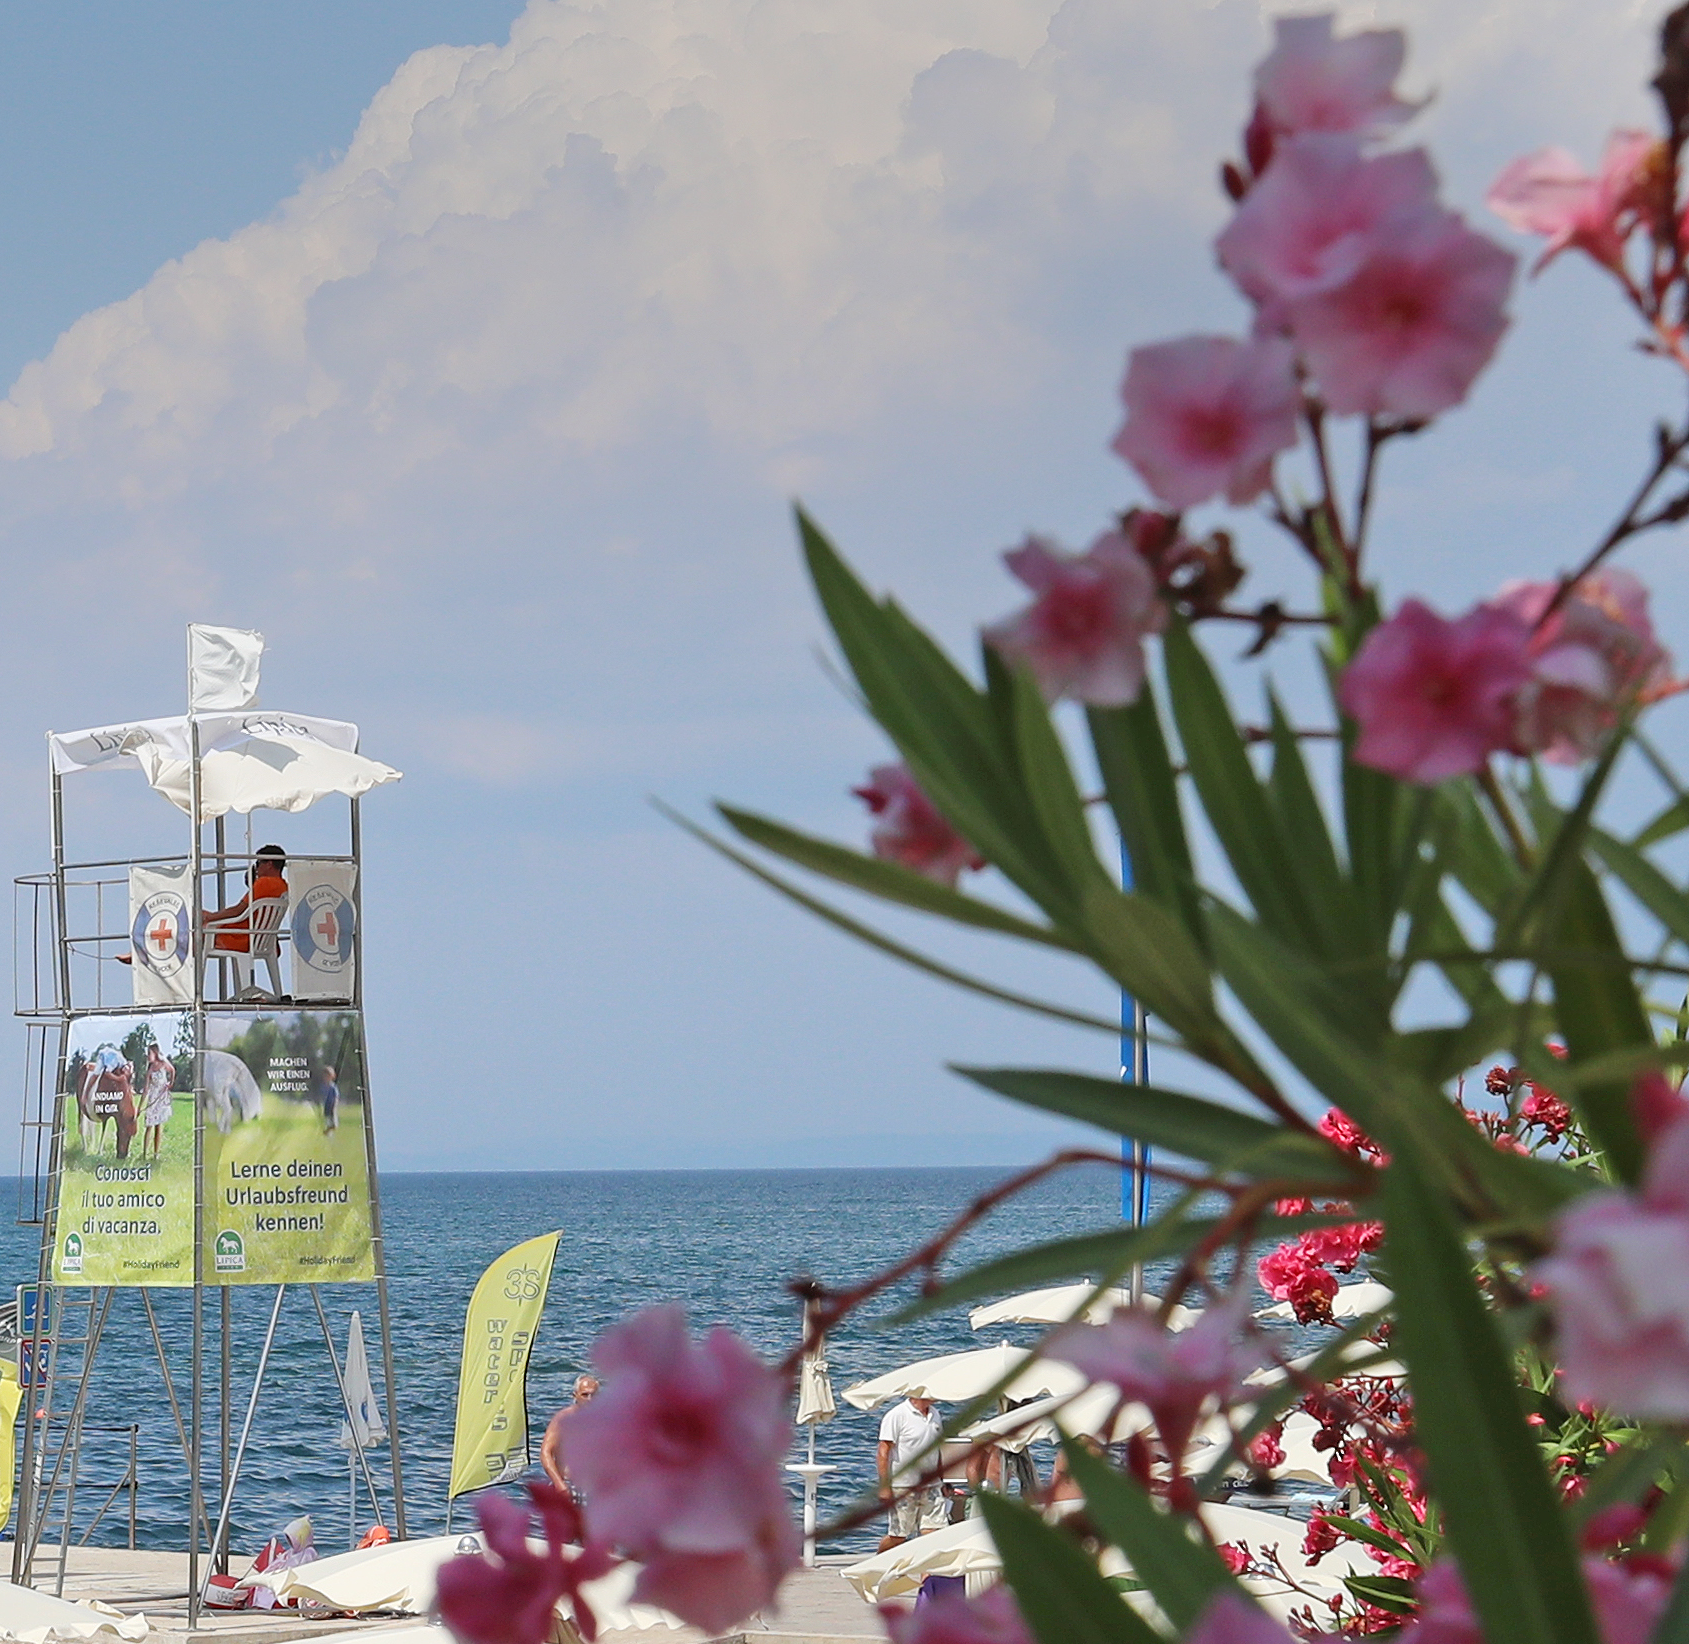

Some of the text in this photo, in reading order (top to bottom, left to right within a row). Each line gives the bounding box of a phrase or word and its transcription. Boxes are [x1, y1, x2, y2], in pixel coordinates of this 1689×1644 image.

[269, 1057, 308, 1067] MACHEN
[267, 1070, 310, 1079] WIR EINEN
[95, 1164, 151, 1181] Conosci
[231, 1159, 342, 1178] Lerne deinen
[82, 1190, 165, 1208] il tuo amico
[226, 1185, 348, 1205] Urlaubsfreund
[83, 1217, 95, 1234] di
[256, 1213, 324, 1231] kennen!
